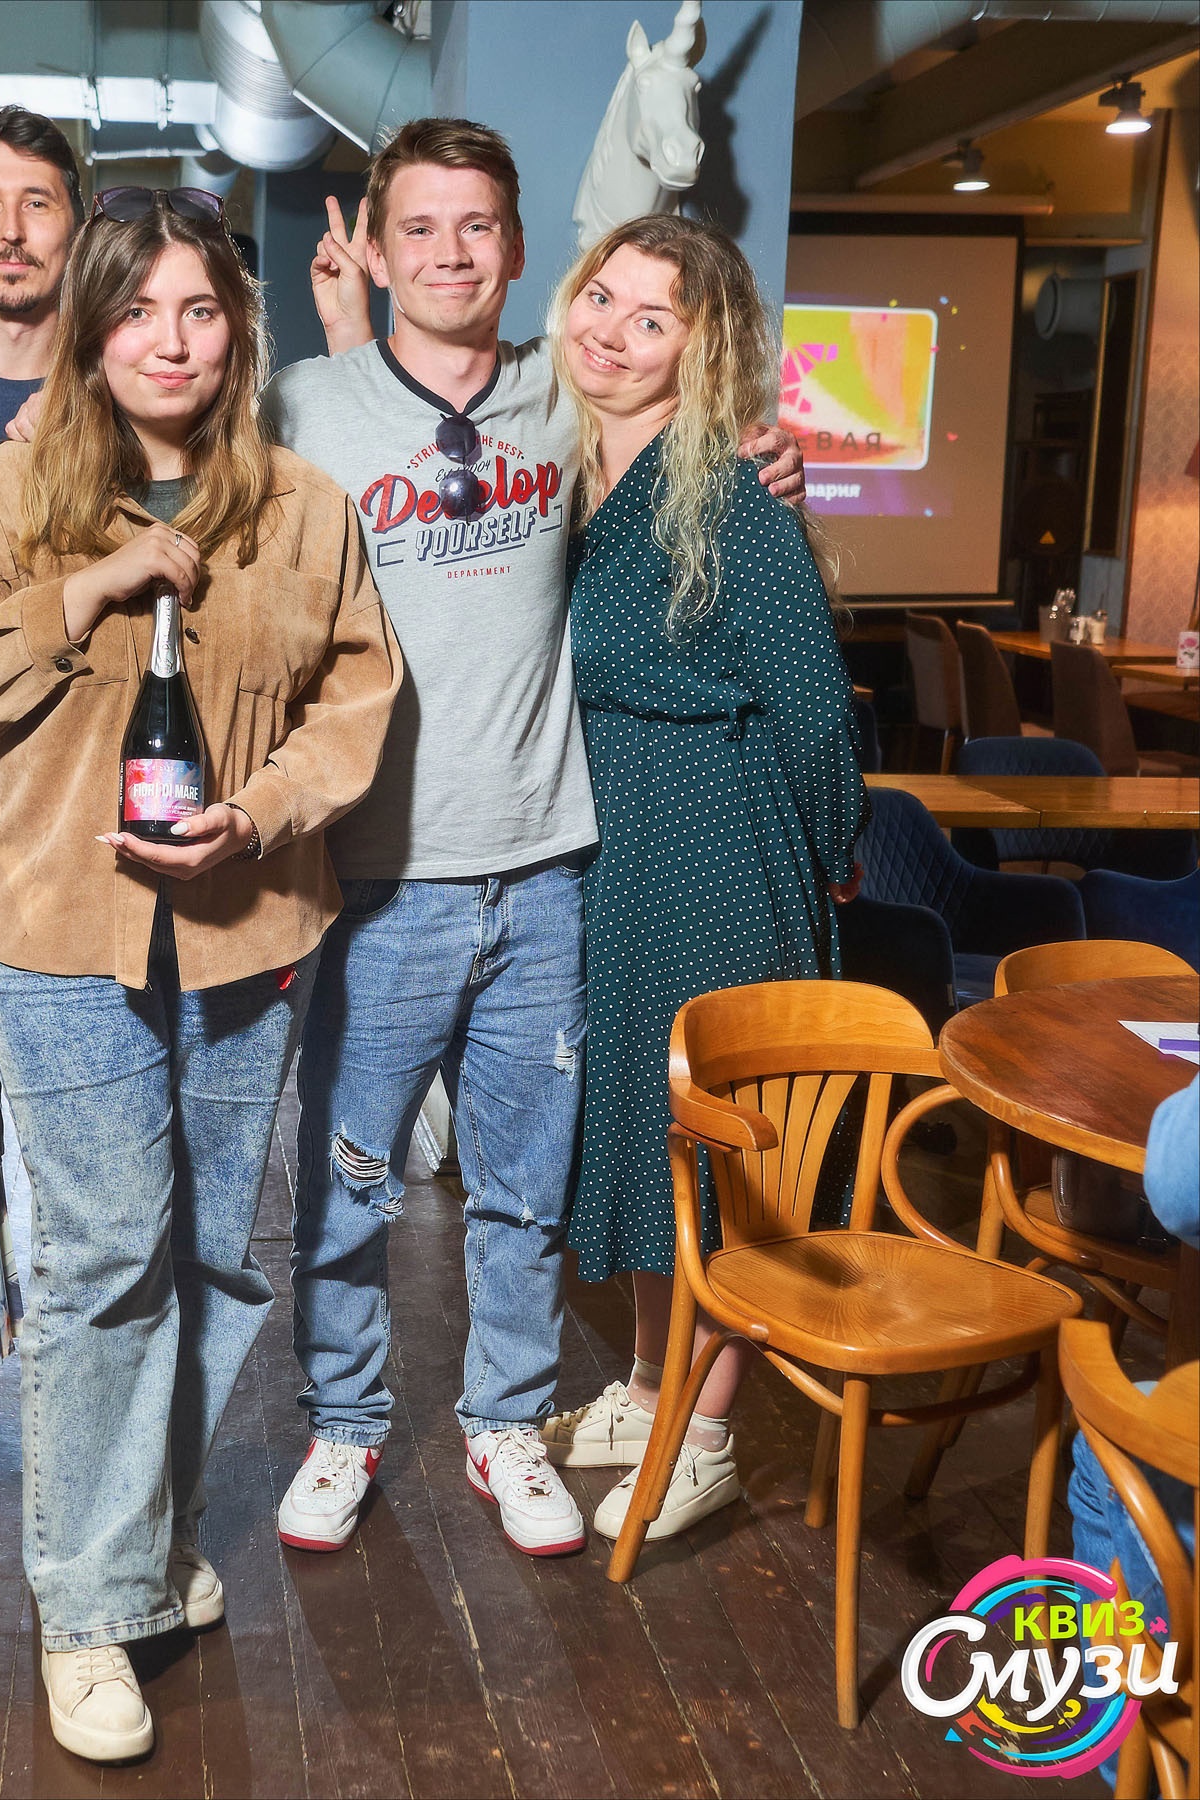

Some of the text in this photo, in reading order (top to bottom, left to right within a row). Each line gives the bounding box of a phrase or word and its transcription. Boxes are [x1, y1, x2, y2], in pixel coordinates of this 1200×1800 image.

[497, 440, 523, 460] BEST
[414, 505, 538, 561] YOURSELF
[447, 565, 511, 579] DEPARTMENT
[175, 784, 199, 801] MARE
